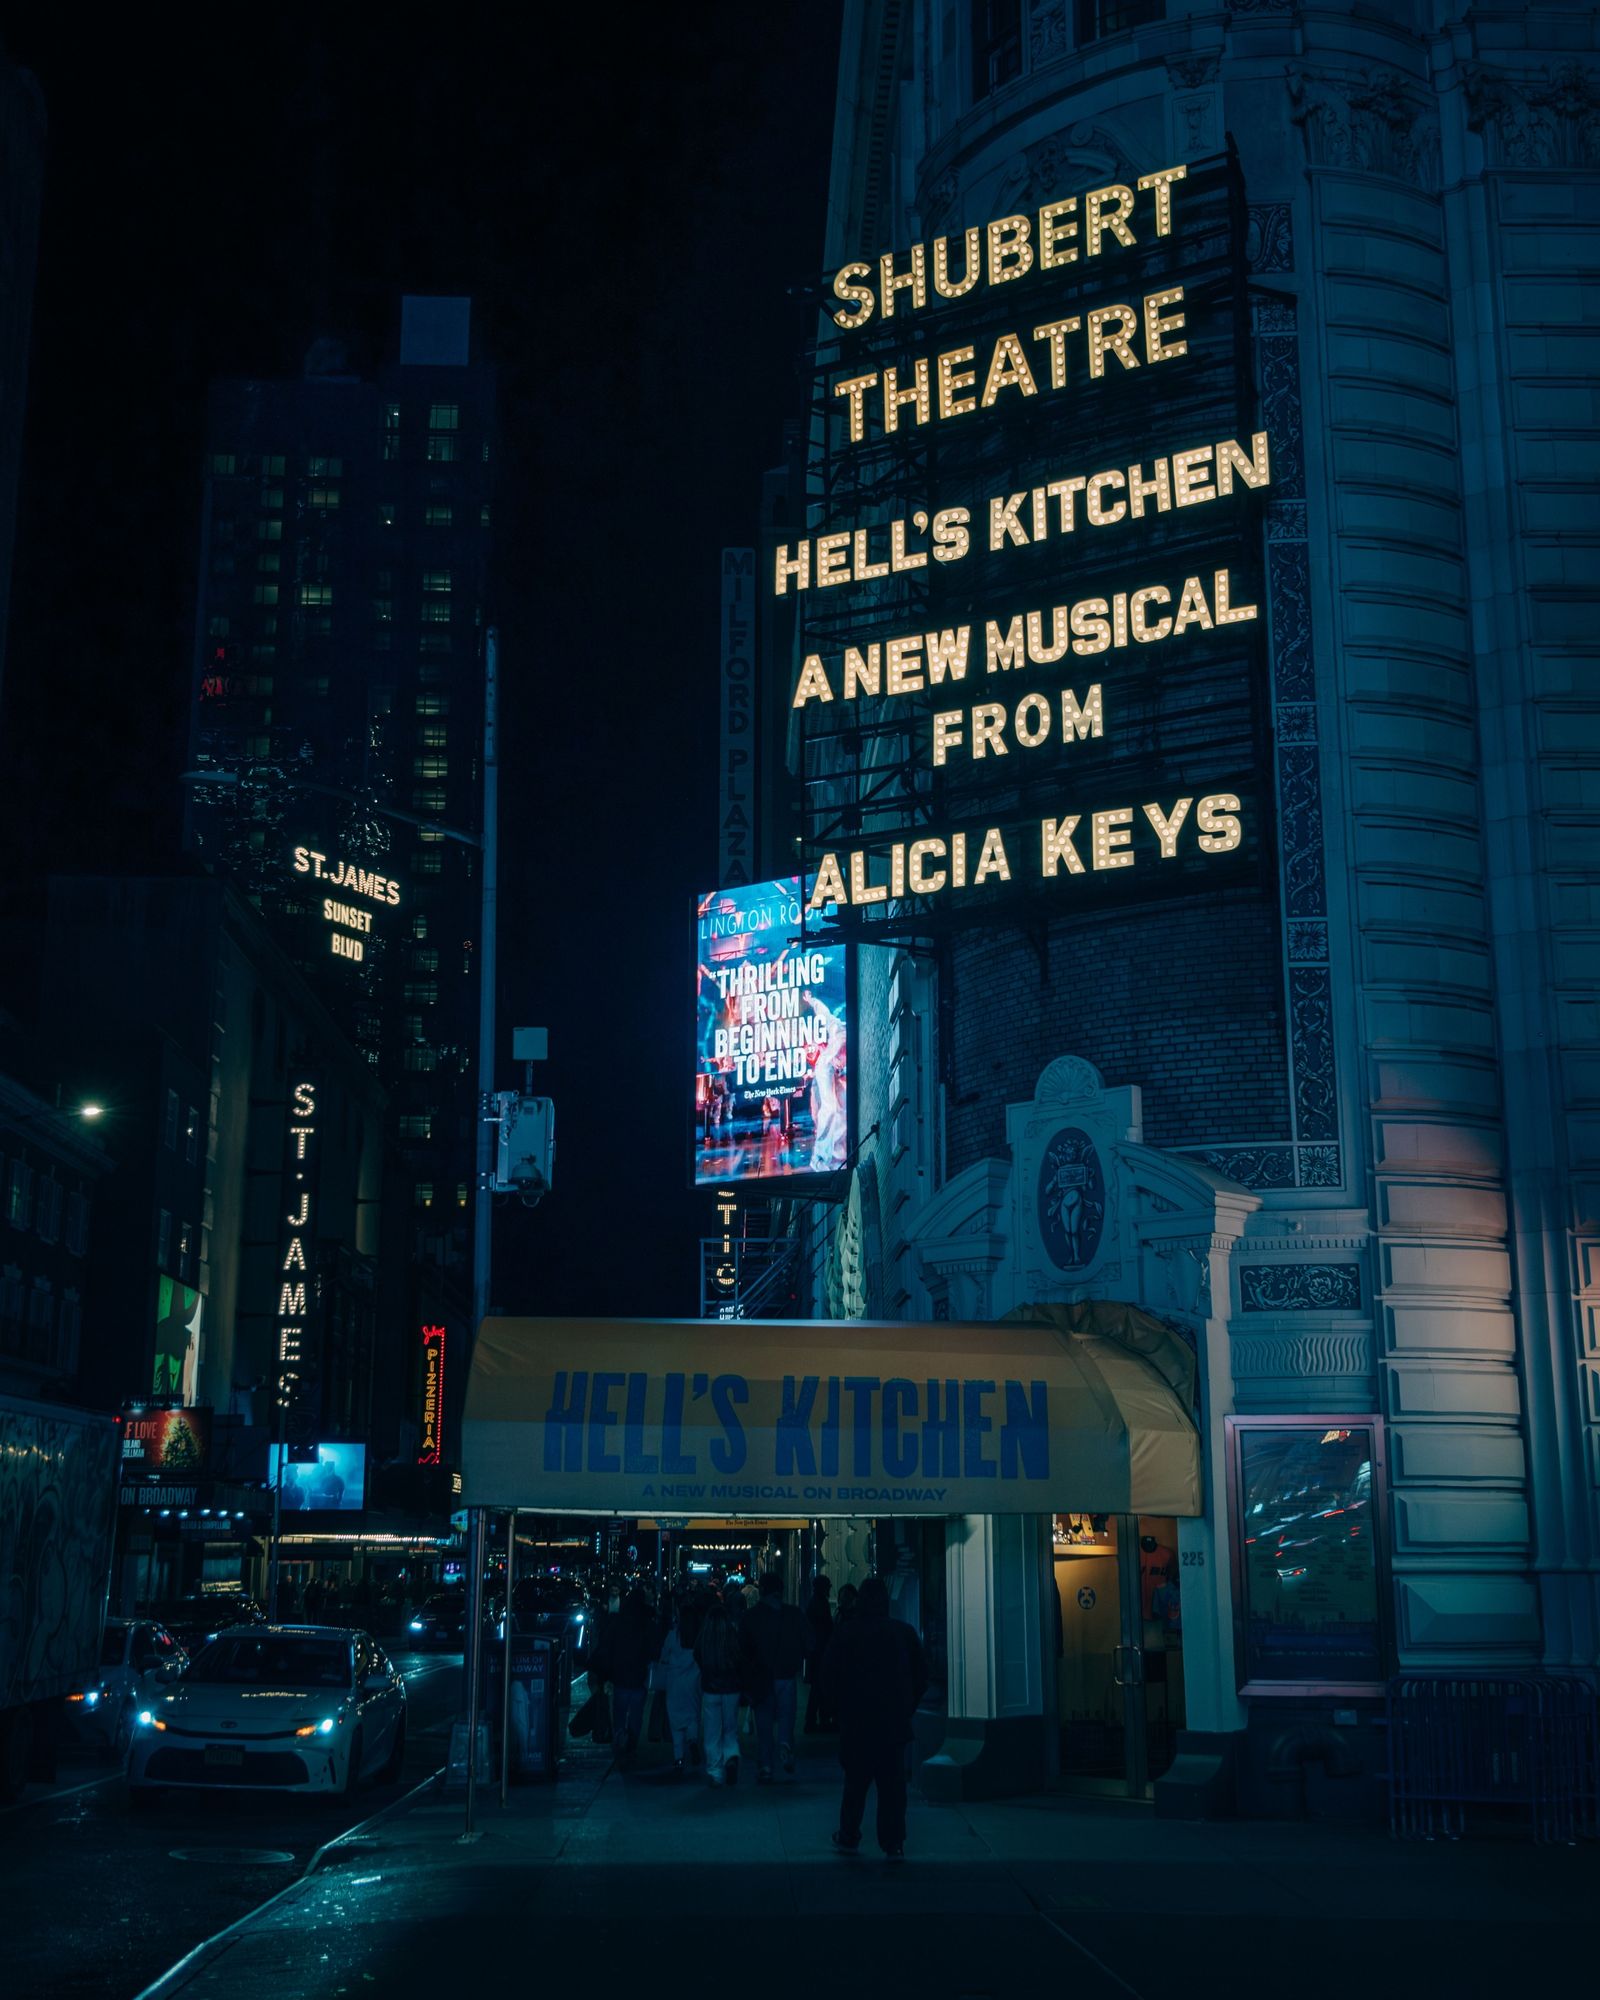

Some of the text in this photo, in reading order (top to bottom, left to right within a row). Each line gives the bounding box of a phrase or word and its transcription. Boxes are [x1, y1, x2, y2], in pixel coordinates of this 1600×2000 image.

[833, 165, 1187, 329] SHUBERT
[835, 286, 1188, 443] THEATRE
[775, 431, 1270, 595] HELL'S KITCHEN
[723, 551, 753, 736] MILFORD
[792, 569, 1258, 708] A NEW MUSICAL
[933, 684, 1104, 766] FROM
[722, 749, 751, 887] PLAZA
[810, 793, 1242, 909] ALICIA KEYS
[323, 898, 373, 933] SUNSET
[331, 932, 364, 962] BLVD
[714, 1014, 828, 1058] BEGINNING
[740, 987, 801, 1024] FROM
[733, 1054, 760, 1086] TO
[754, 1089, 766, 1098] New
[779, 1085, 796, 1095] Times
[134, 1421, 158, 1439] LOVE
[422, 1348, 438, 1449] PIZZERIA
[543, 1371, 1051, 1479] HELL'S KITCHEN
[138, 1487, 199, 1505] BROADWAY
[641, 1484, 948, 1501] A NEW MUSICAL ON BROADWAY
[1181, 1551, 1205, 1566] 225
